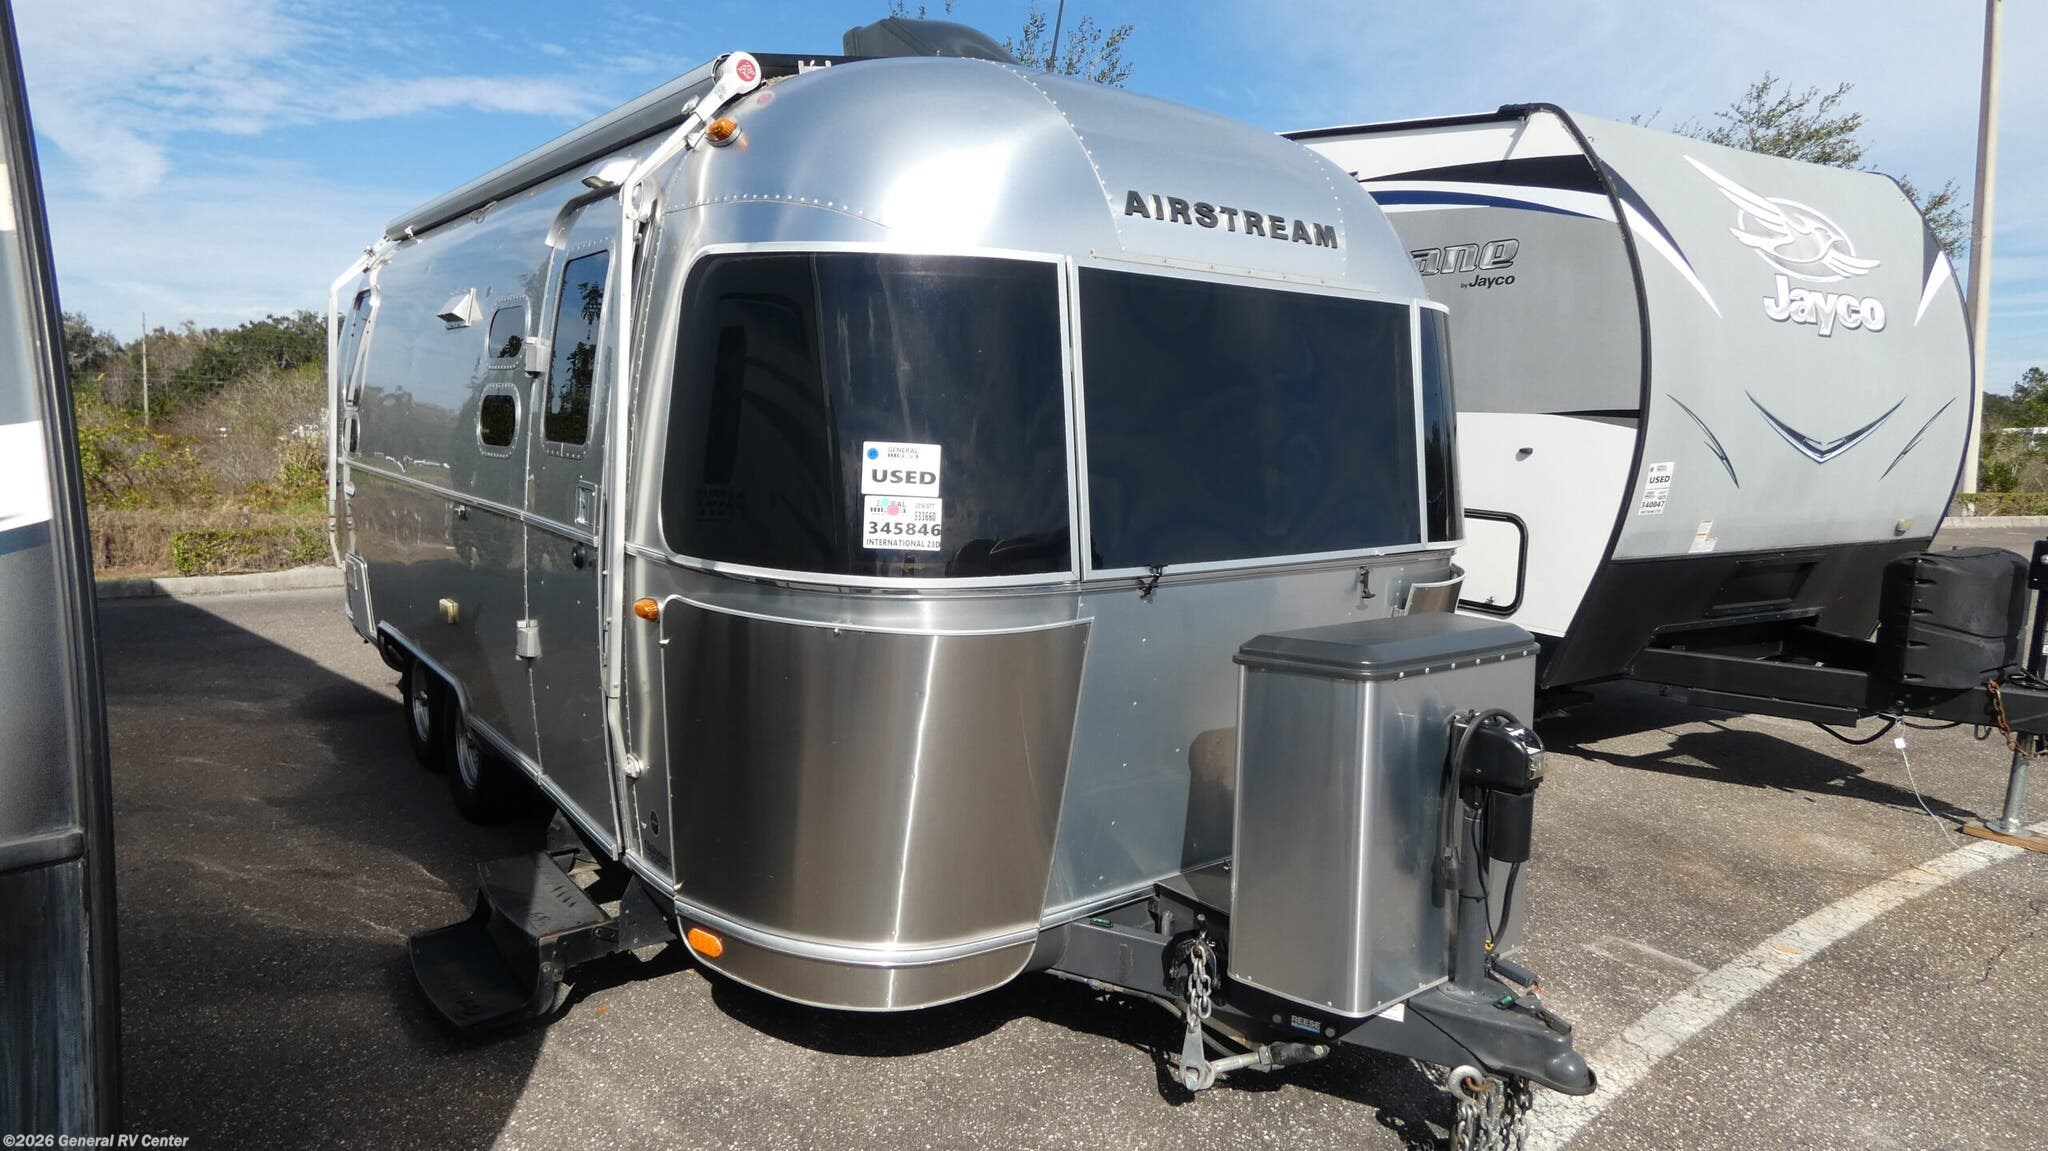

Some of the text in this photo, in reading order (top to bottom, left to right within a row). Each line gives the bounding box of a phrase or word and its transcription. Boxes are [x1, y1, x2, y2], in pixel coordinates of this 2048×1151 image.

[1124, 190, 1338, 249] AIRSTREAM
[1409, 238, 1520, 277] ane
[1468, 274, 1516, 289] Jayco
[1762, 273, 1887, 338] Jayco
[871, 469, 936, 485] USED
[1649, 475, 1670, 484] USED
[868, 521, 941, 537] 345846
[866, 538, 925, 548] INTERNATIONAL
[1291, 1014, 1321, 1029] REESE
